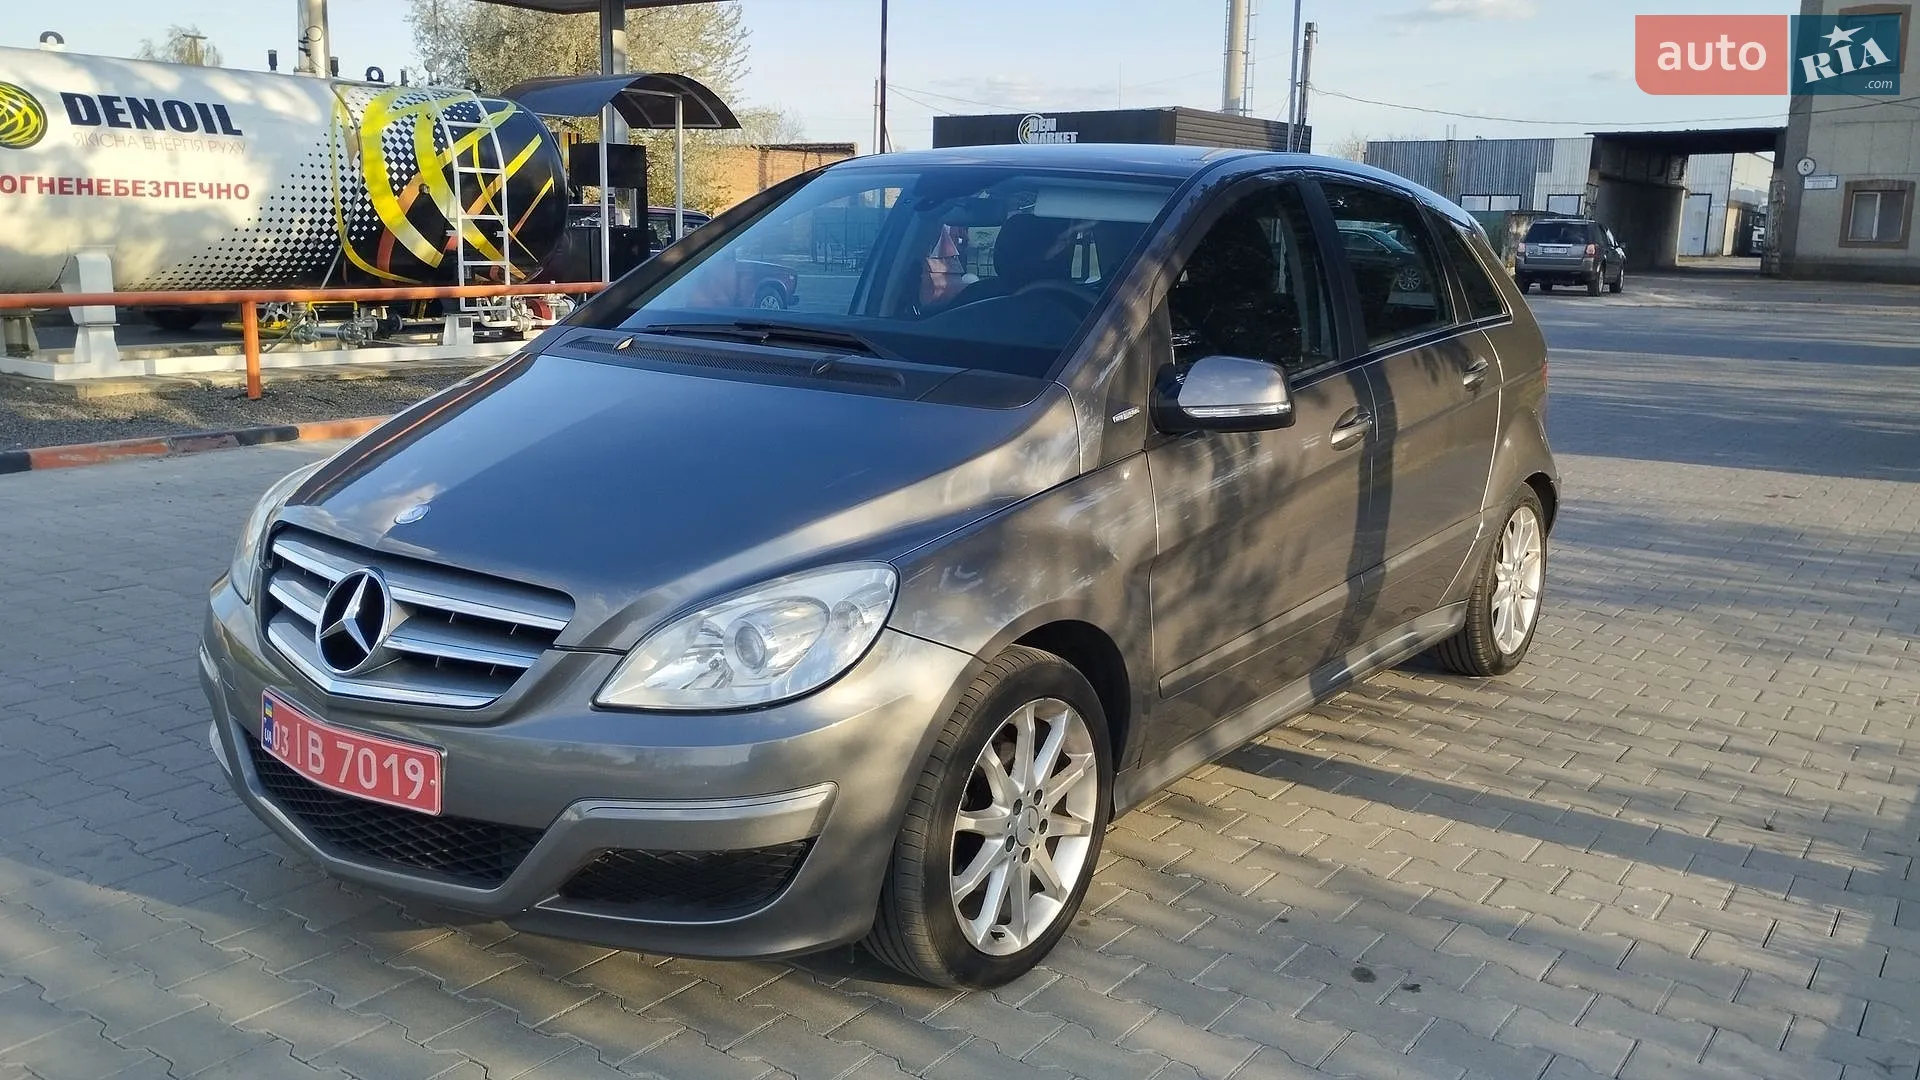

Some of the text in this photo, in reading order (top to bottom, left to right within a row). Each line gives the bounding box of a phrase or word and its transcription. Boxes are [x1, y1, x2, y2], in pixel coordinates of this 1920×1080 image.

[60, 92, 243, 136] DENOIL
[72, 131, 246, 155] ЯКІСНА ЕНЕРГІЯ РУХУ
[1029, 131, 1079, 144] MARKET
[0, 175, 250, 200] ОГНЕНЕБЕЗПЕЧНО
[272, 720, 289, 757] 03
[336, 740, 425, 800] 7019
